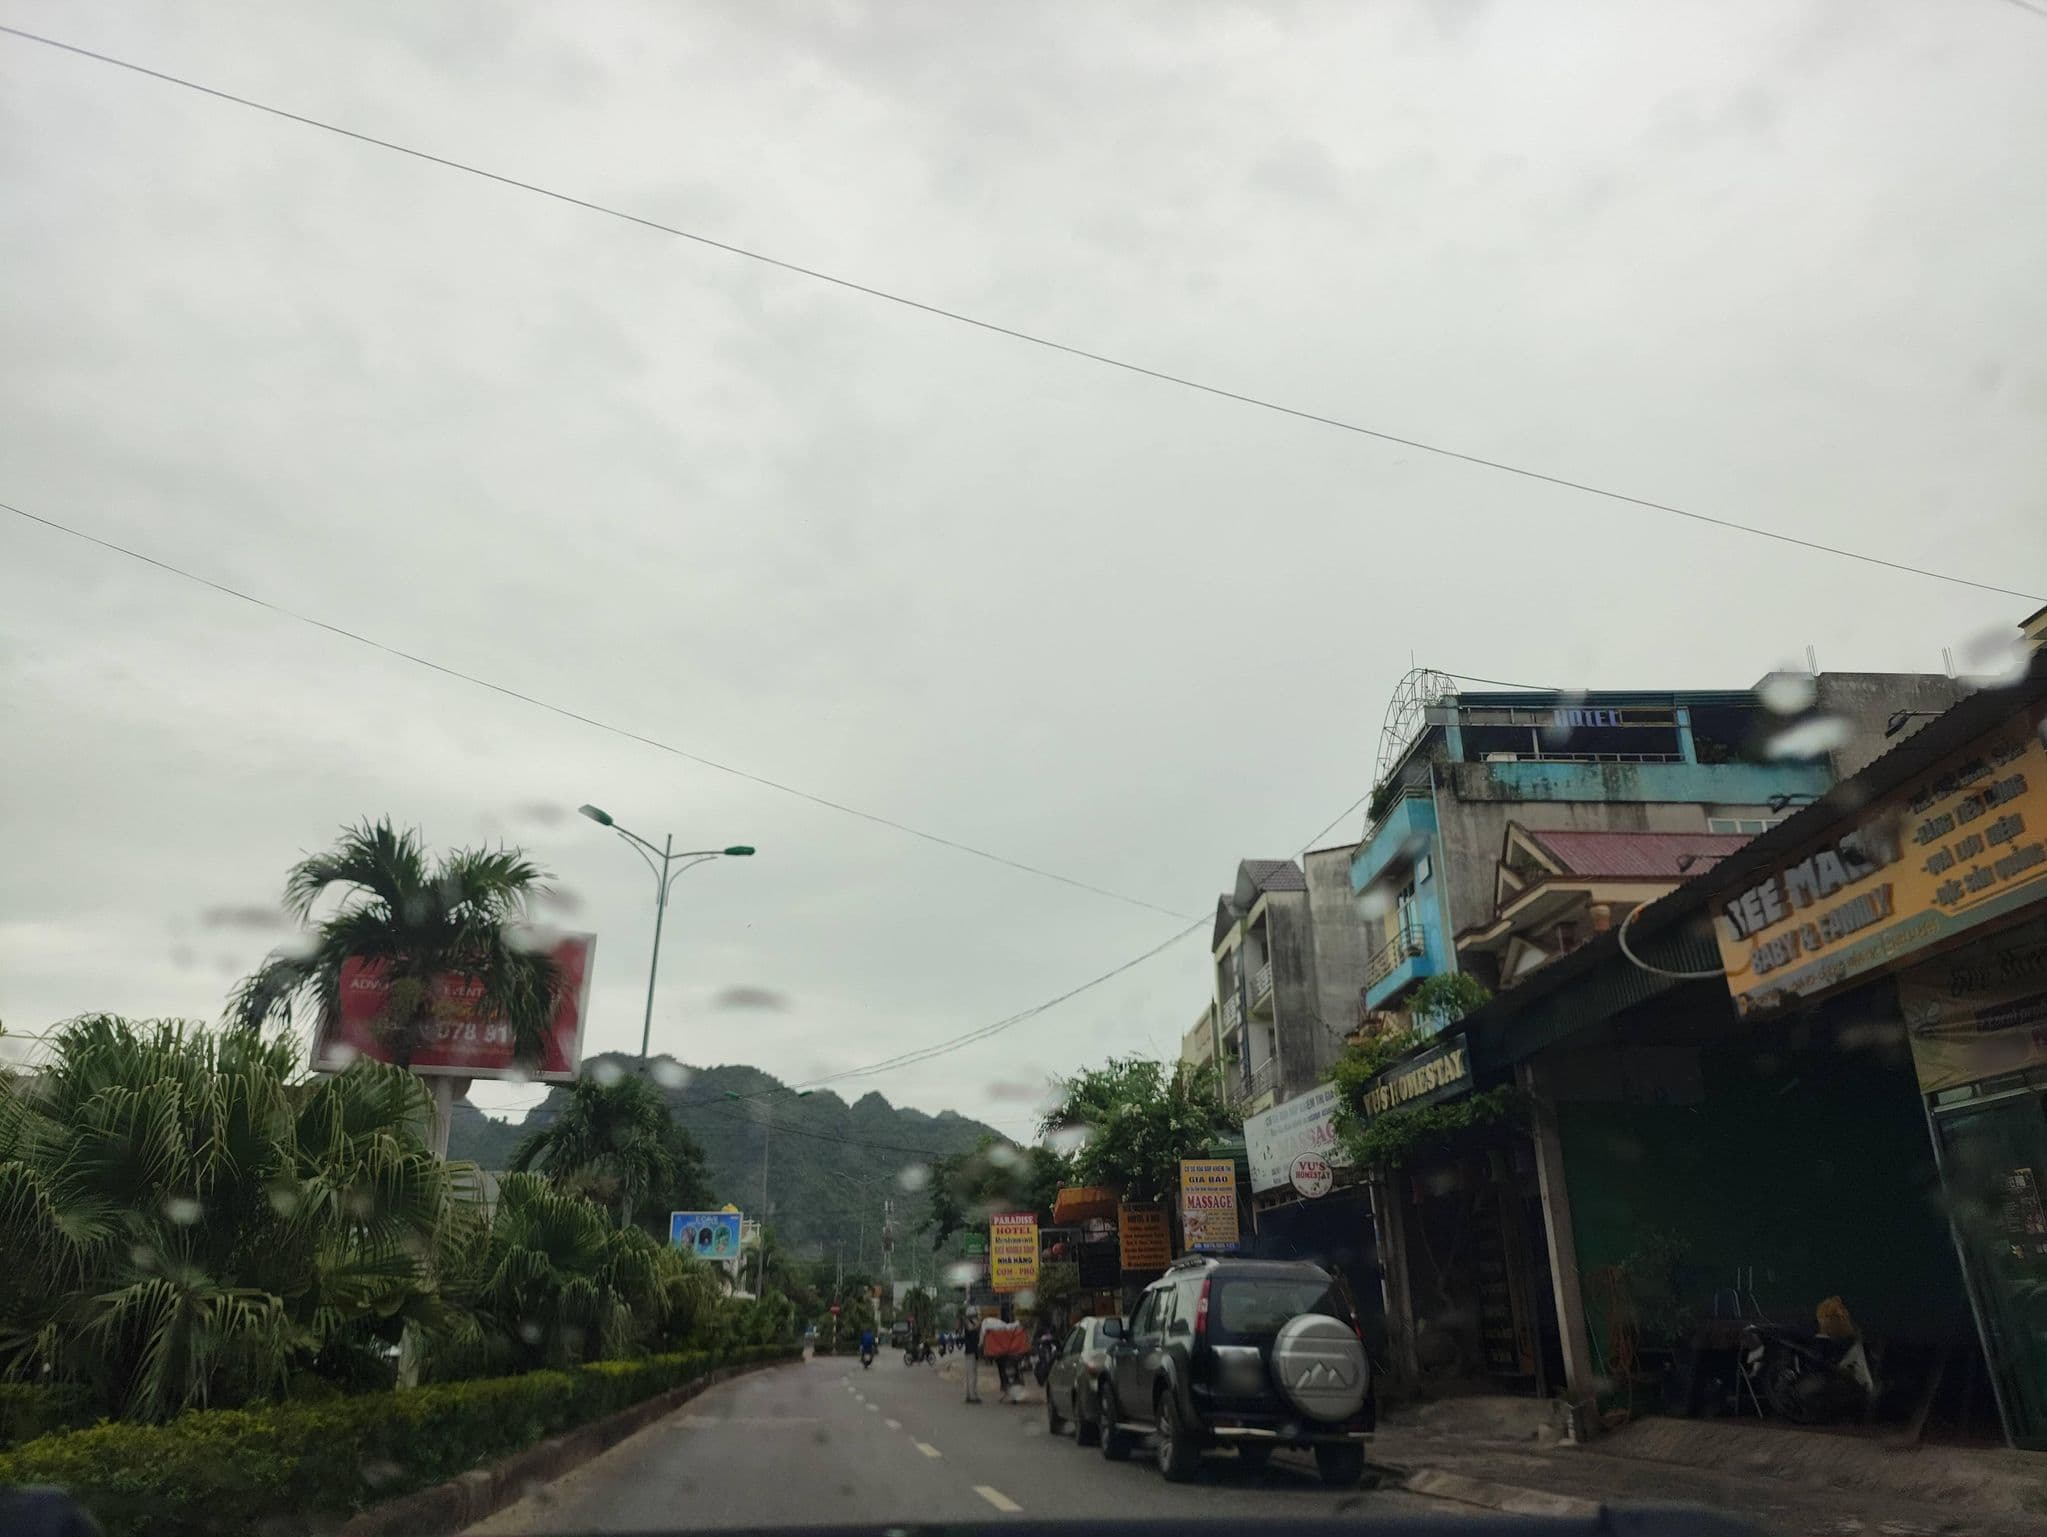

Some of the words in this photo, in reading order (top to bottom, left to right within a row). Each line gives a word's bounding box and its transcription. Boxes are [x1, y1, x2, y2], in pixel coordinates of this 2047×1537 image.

[1752, 929, 1800, 974] BABY
[1819, 883, 1896, 944] FAMILY
[1299, 1161, 1326, 1171] VU'S
[1295, 1171, 1331, 1180] HOMESTAY
[1187, 1195, 1233, 1209] MASSAGE
[993, 1215, 1034, 1224] PARADISE
[996, 1226, 1033, 1234] HOTEL
